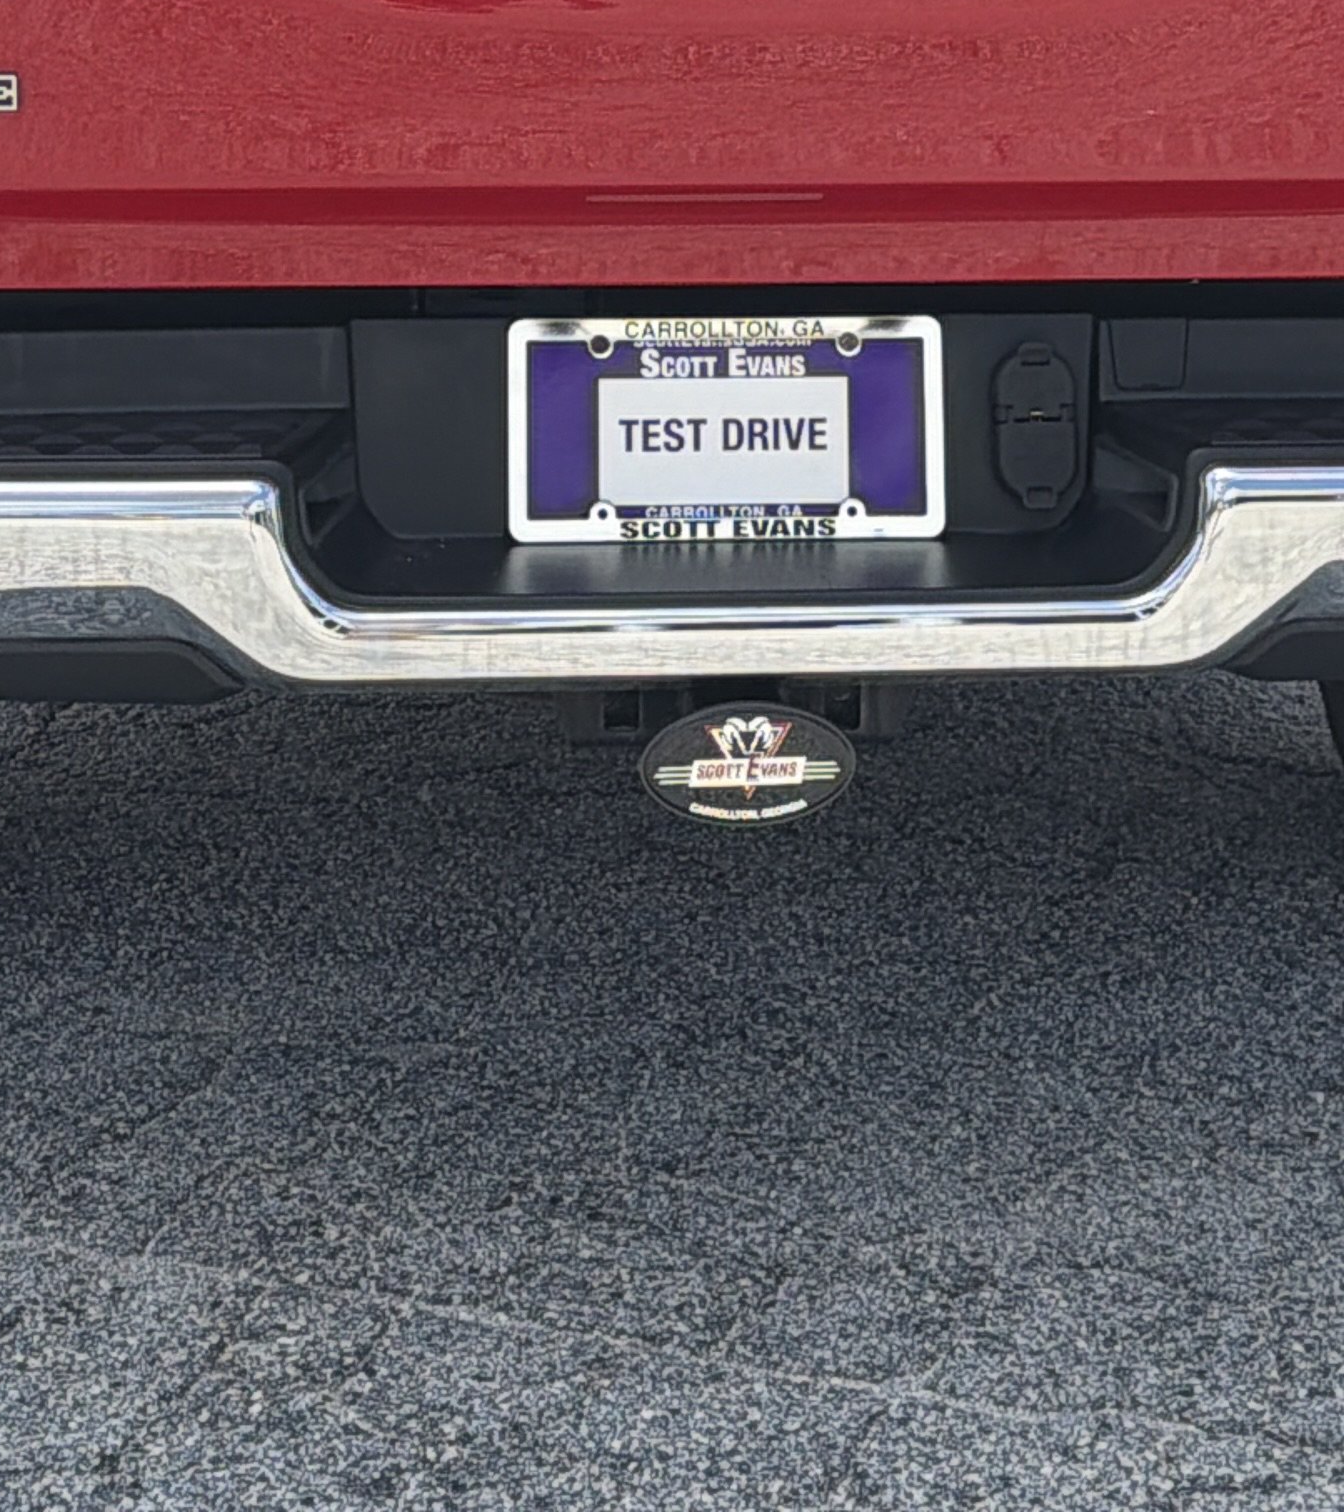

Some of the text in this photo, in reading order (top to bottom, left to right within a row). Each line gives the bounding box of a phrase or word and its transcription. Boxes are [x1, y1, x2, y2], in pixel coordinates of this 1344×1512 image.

[792, 319, 825, 337] GA
[618, 417, 828, 452] TEST DRIVE
[776, 505, 803, 517] GA
[619, 519, 837, 538] SCOTT EVANS
[696, 752, 798, 781] SCOTT EVANS
